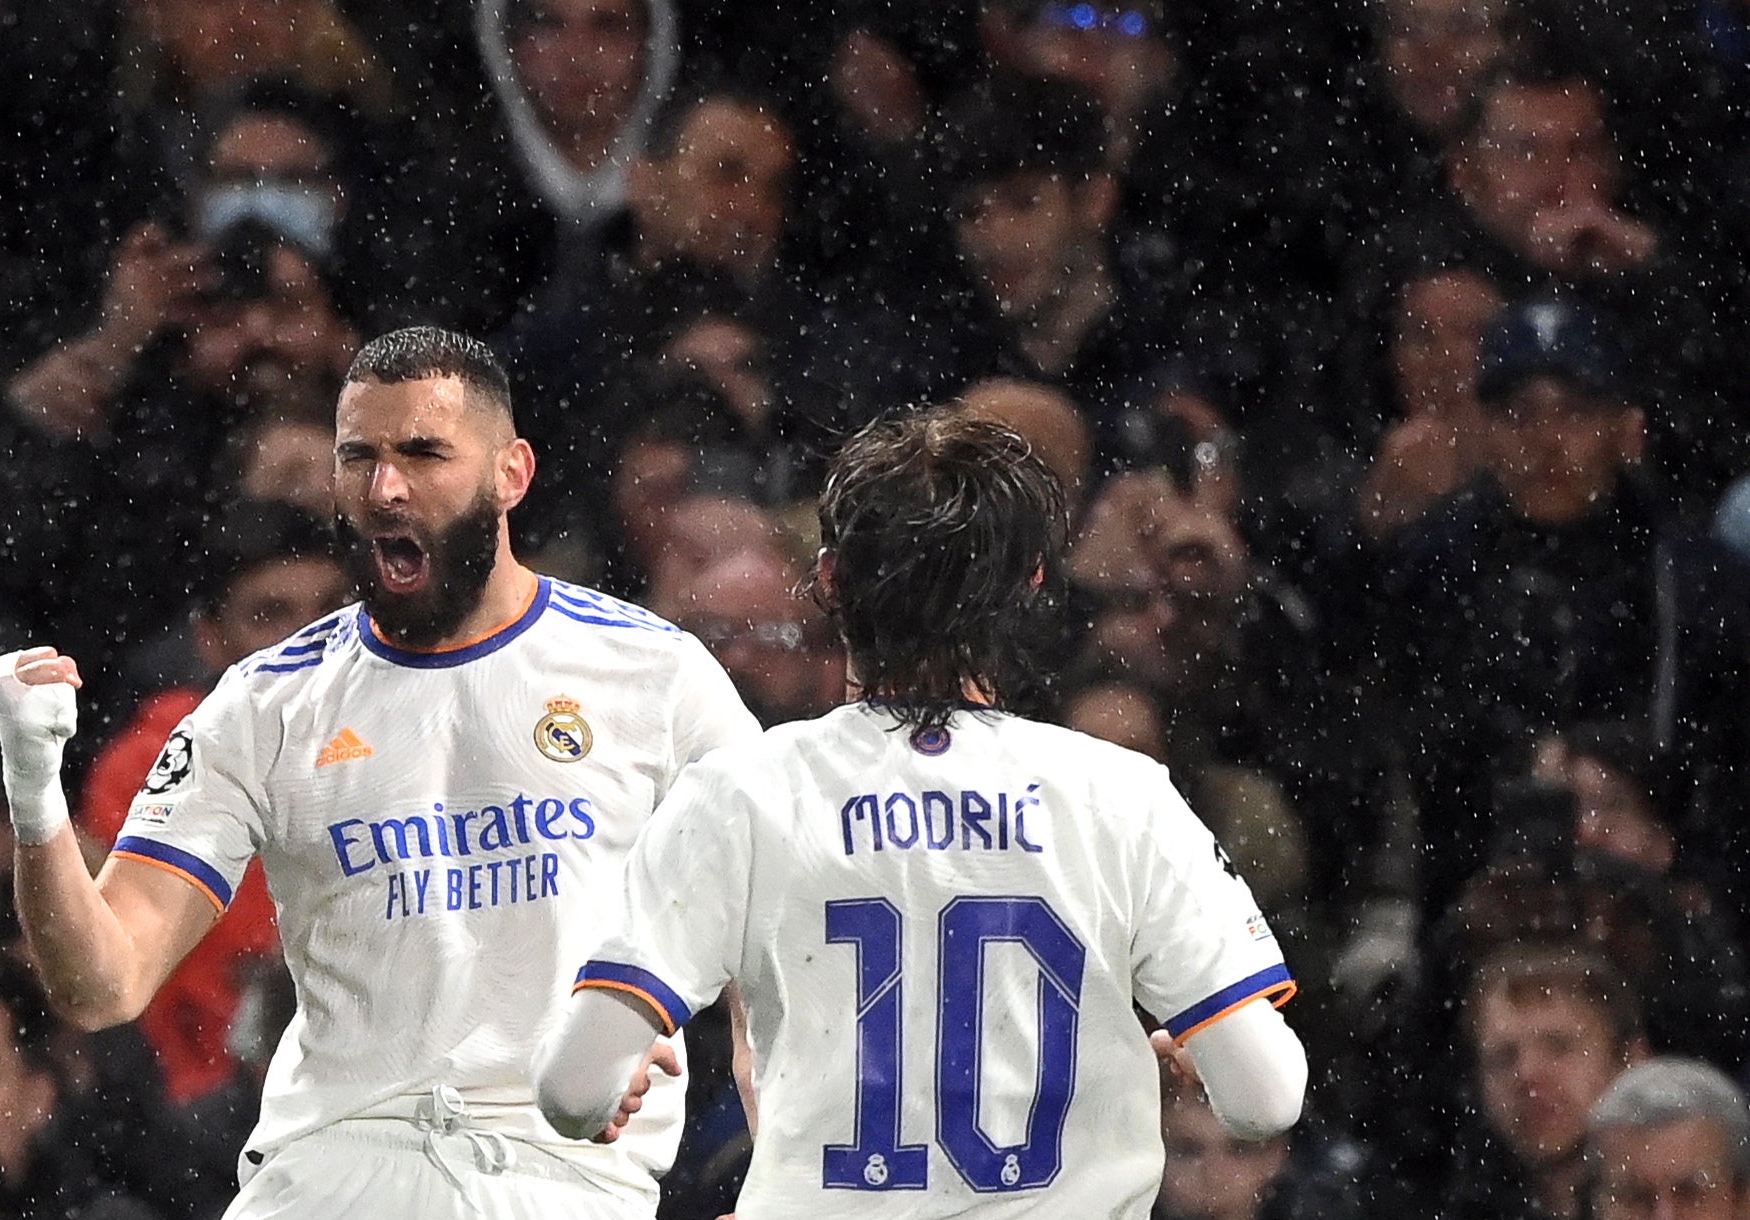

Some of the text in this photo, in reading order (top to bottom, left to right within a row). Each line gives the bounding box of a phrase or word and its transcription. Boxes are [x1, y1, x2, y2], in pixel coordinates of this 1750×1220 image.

[315, 746, 373, 769] adidas
[327, 792, 596, 878] Emirates
[842, 783, 1045, 856] MODRIĆ
[386, 853, 559, 920] FLY BETTER
[822, 895, 1088, 1194] 10
